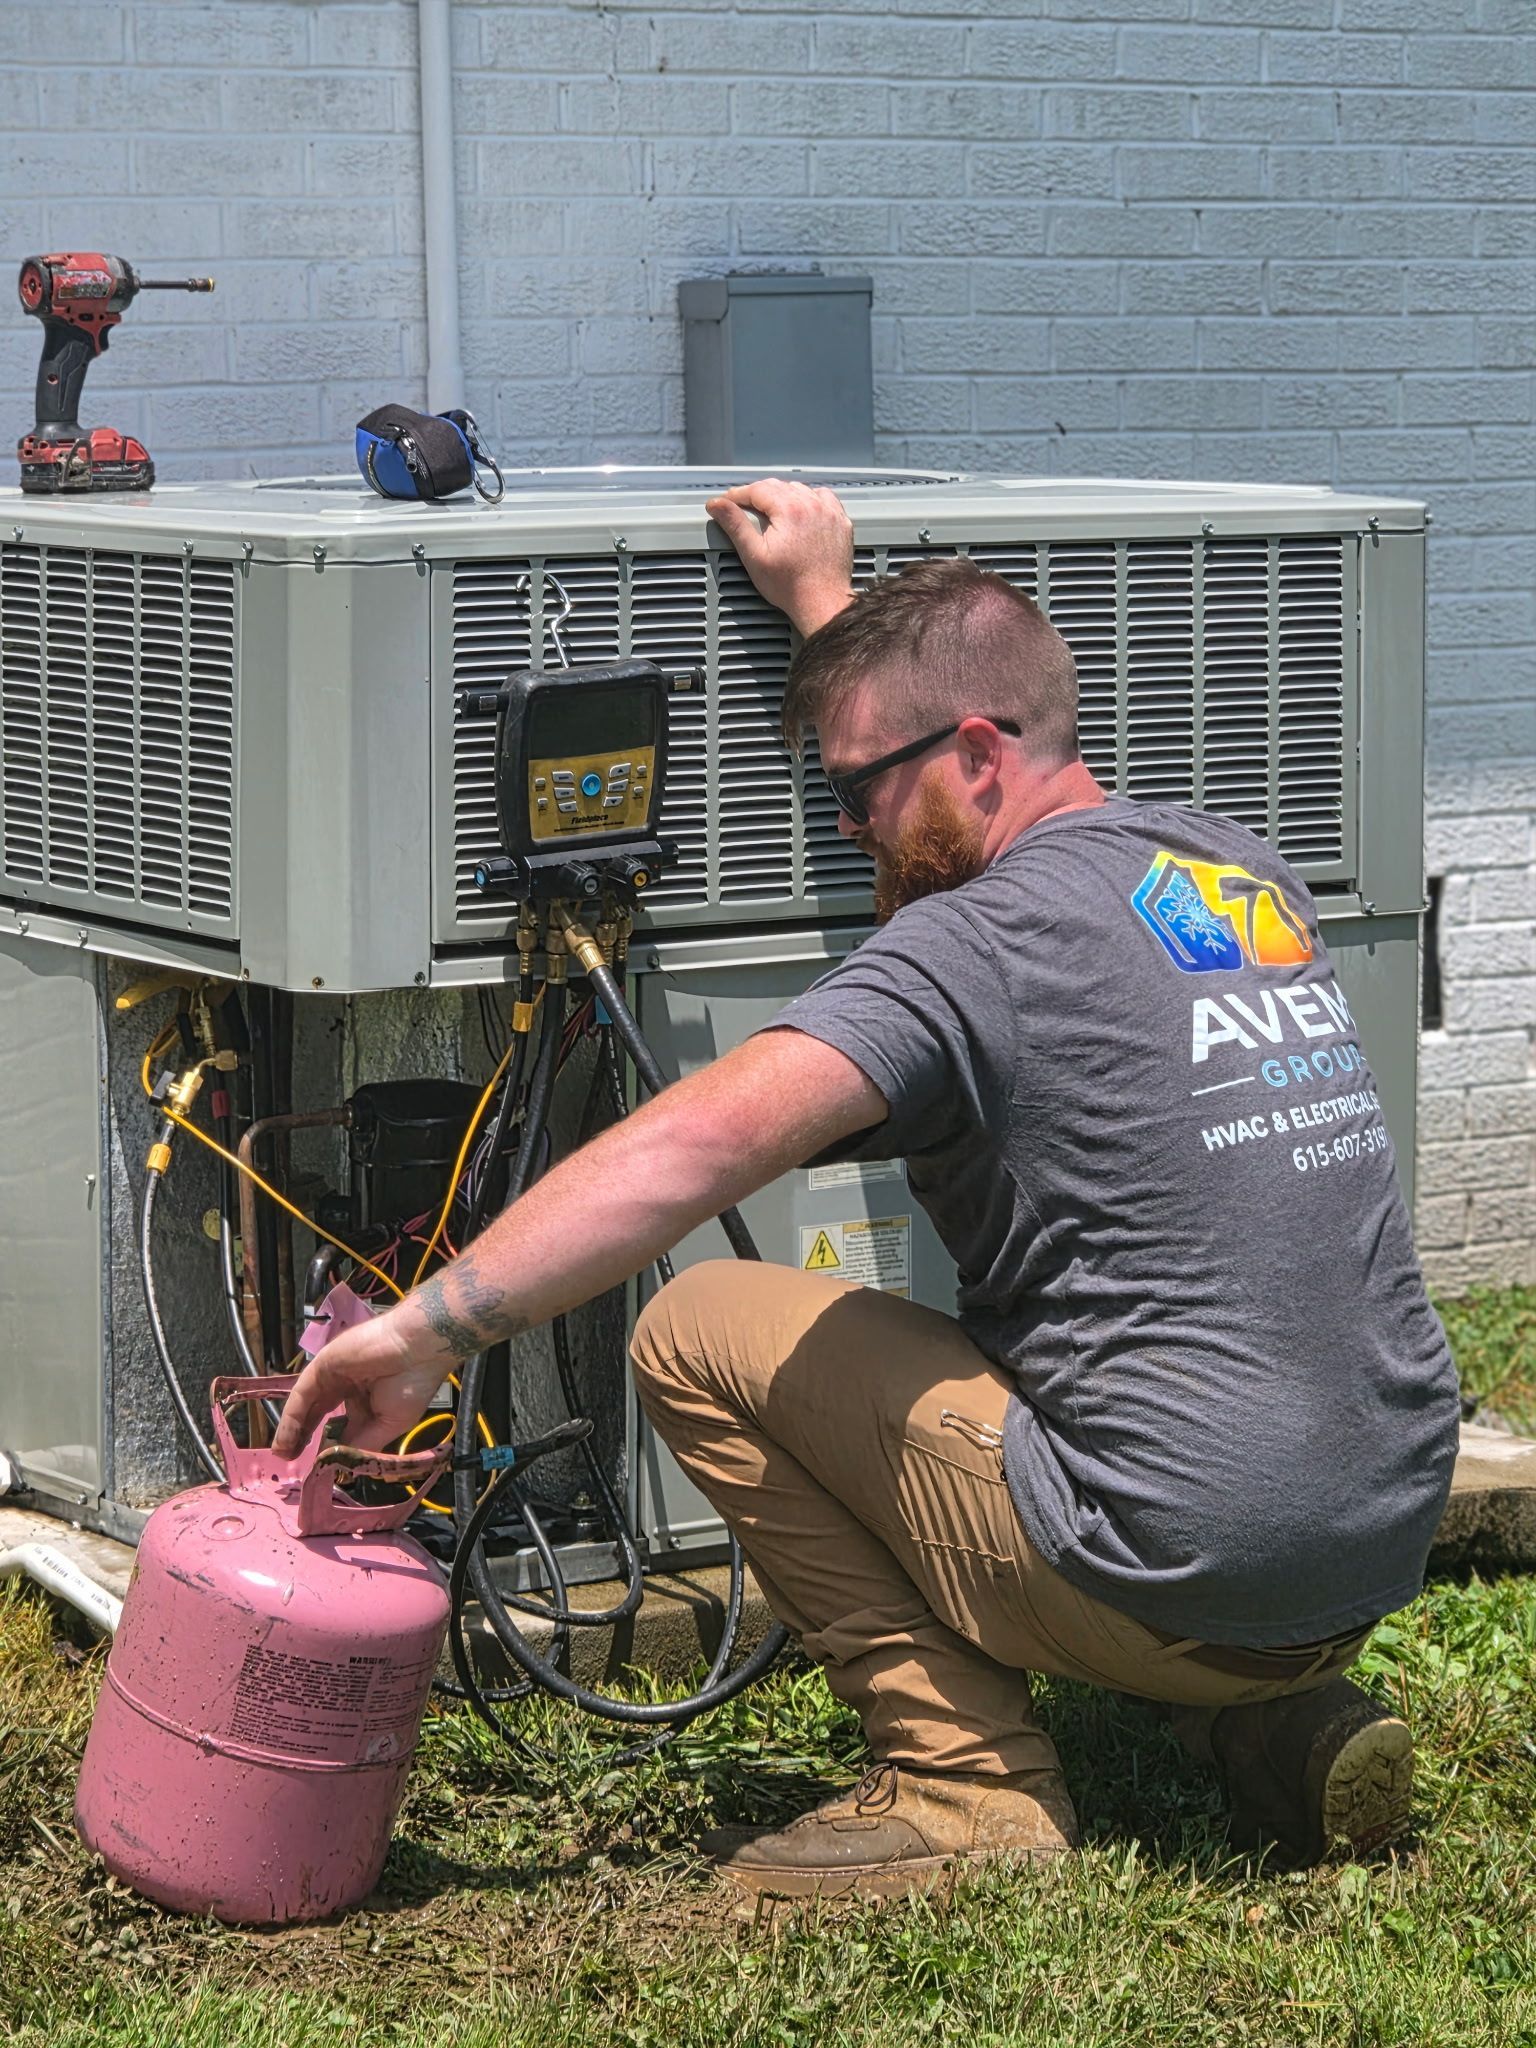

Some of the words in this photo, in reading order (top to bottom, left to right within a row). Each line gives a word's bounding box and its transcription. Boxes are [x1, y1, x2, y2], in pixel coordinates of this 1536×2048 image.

[1201, 1115, 1269, 1151] HVAC
[1271, 1111, 1290, 1133] &
[1289, 1090, 1374, 1129] ELECTRICAL
